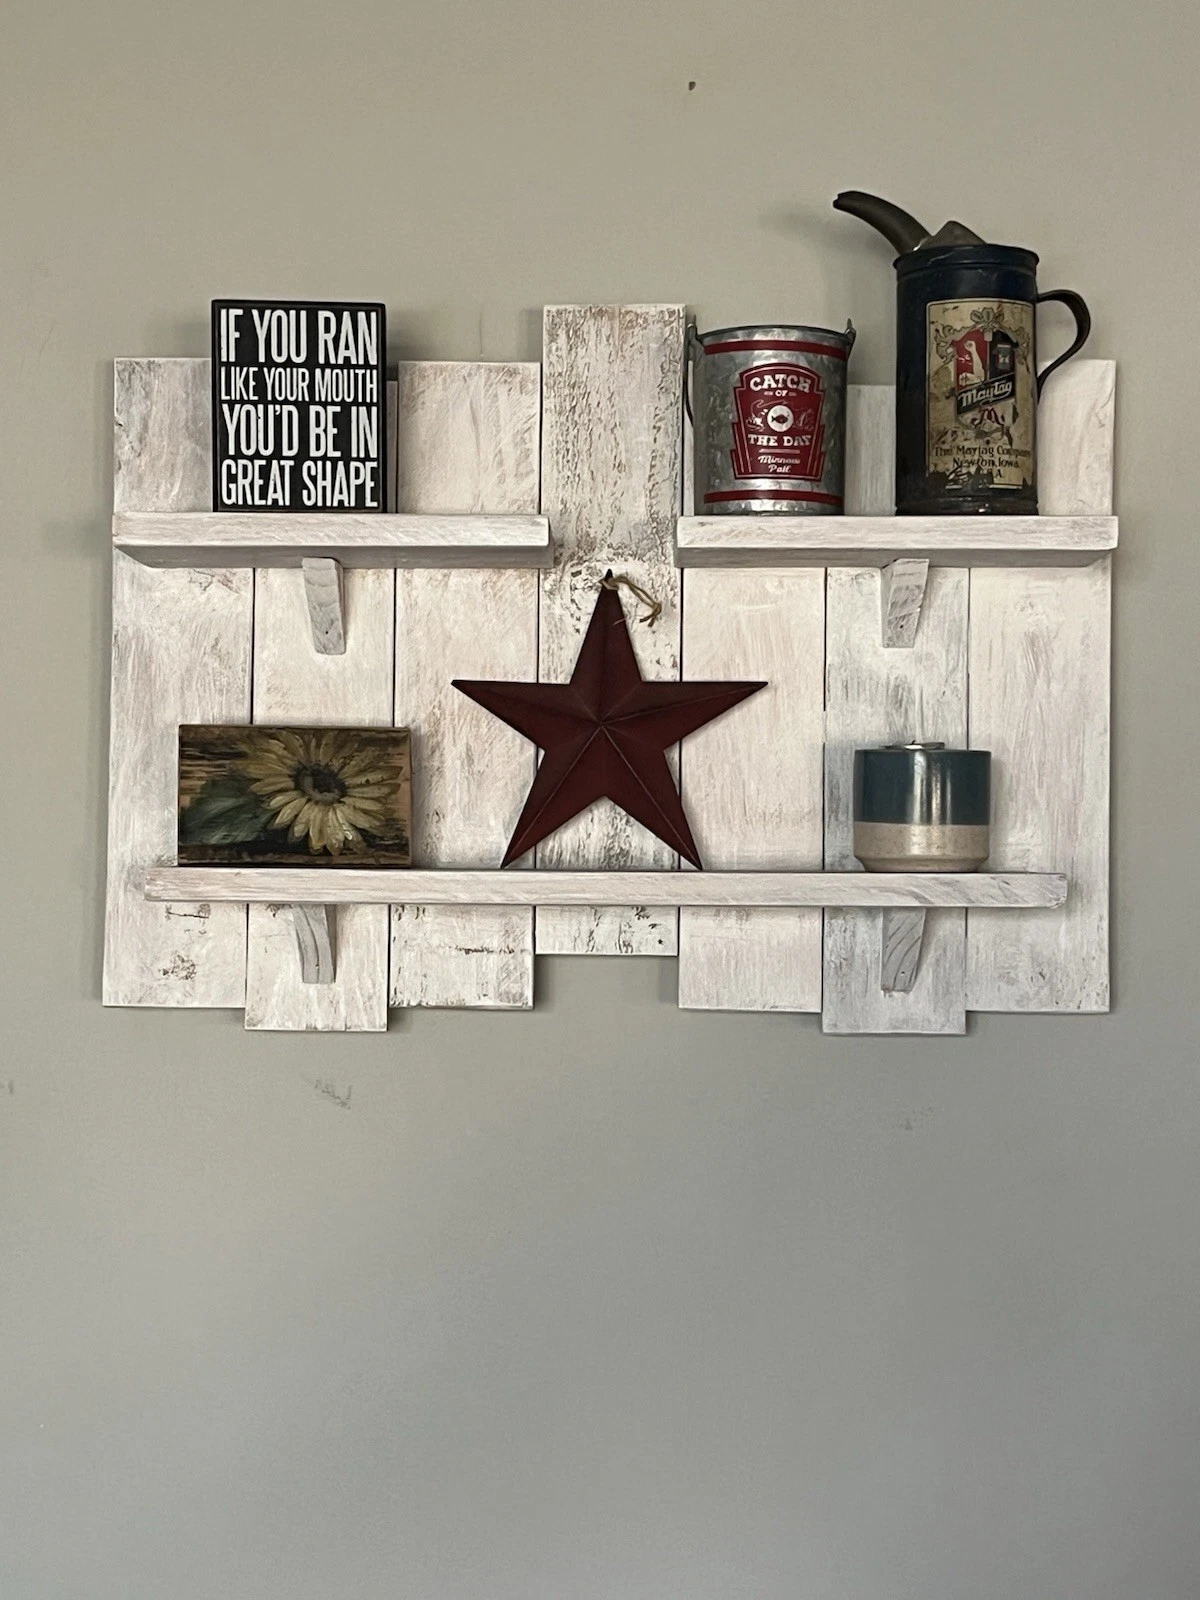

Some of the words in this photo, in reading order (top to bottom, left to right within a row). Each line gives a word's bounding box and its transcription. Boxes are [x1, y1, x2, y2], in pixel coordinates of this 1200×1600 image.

[220, 308, 243, 362] IF
[251, 309, 307, 363] YOU
[317, 310, 378, 365] RAN
[220, 366, 259, 400] LIKE
[263, 367, 310, 401] YOUR
[314, 368, 377, 403] MOUTH
[750, 374, 811, 393] CATCH
[957, 381, 1013, 407] Maytag
[221, 403, 299, 457] YOU'D
[308, 405, 341, 458] BE
[351, 406, 378, 459] IN
[747, 434, 778, 447] THE
[783, 435, 812, 447] DAY
[956, 445, 994, 457] Maytag
[768, 464, 792, 473] Pail
[998, 457, 1020, 468] Iowa
[221, 459, 295, 506] GREAT
[302, 460, 378, 507] SHAPE
